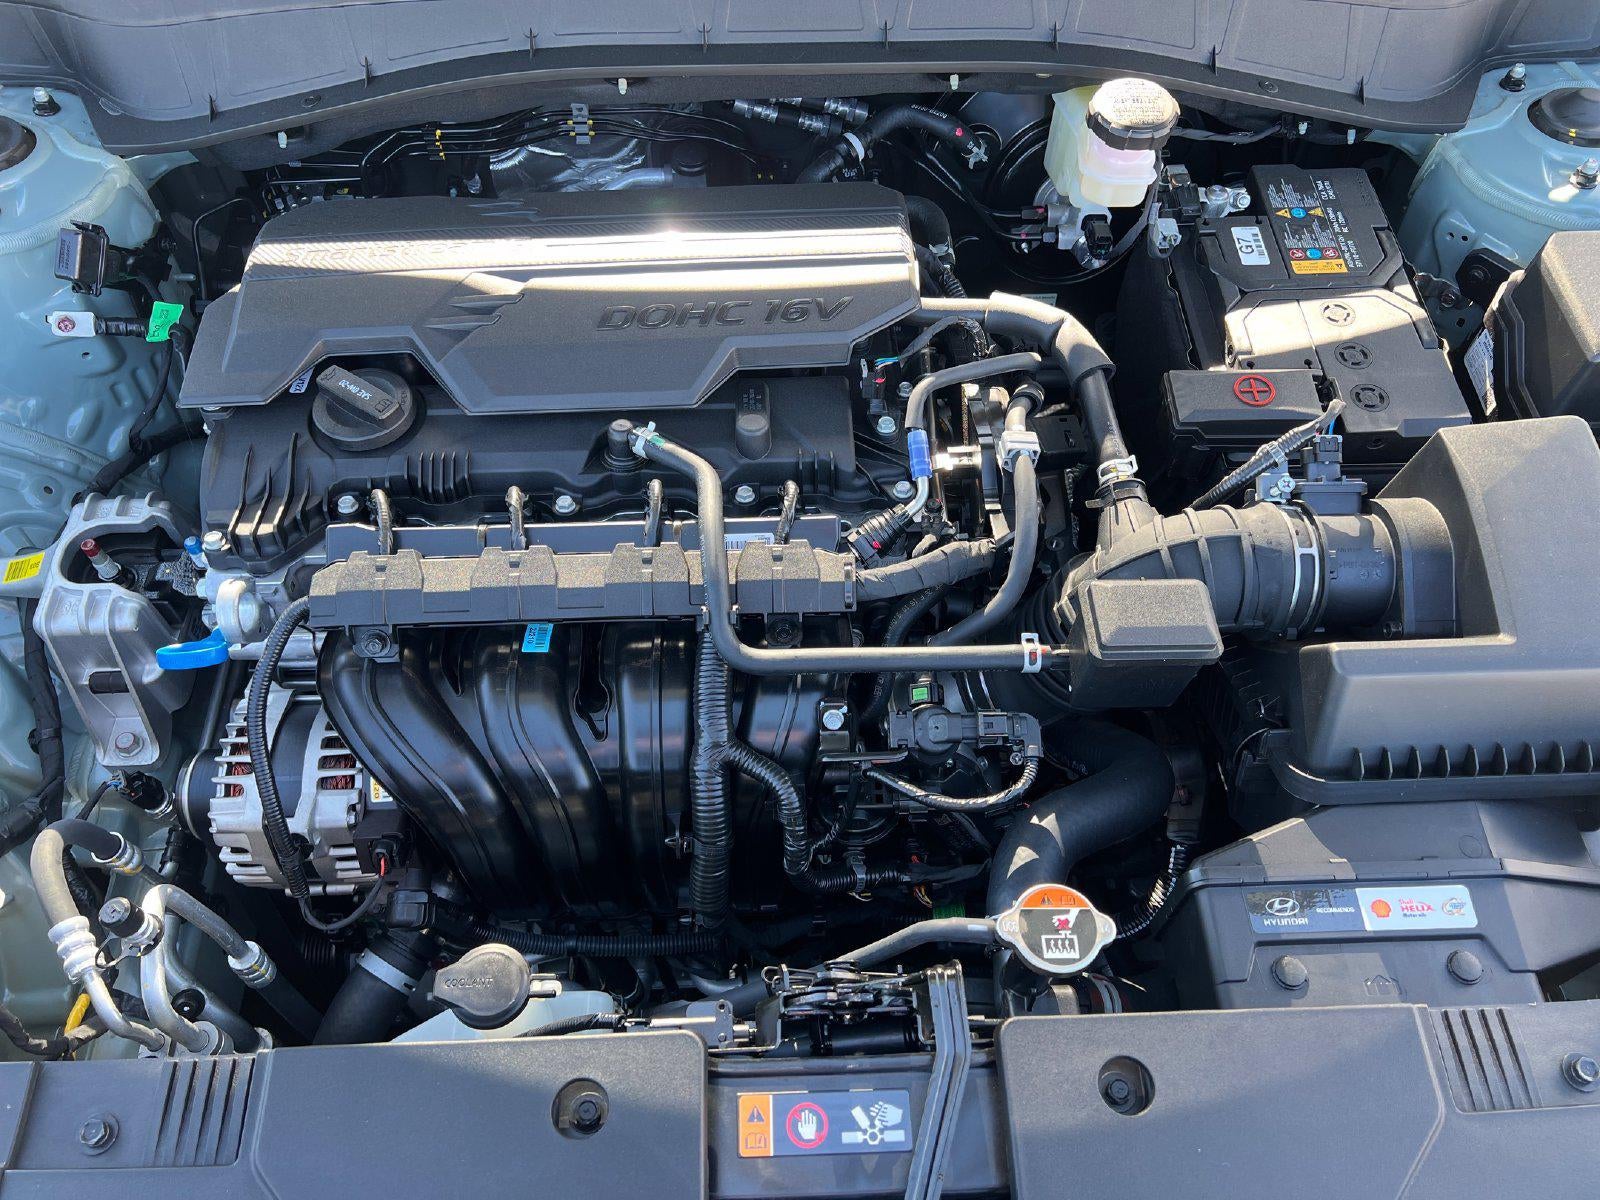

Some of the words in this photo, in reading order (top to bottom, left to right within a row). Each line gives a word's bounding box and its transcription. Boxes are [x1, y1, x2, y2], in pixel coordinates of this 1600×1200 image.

[1236, 237, 1255, 255] G7
[597, 300, 753, 332] DOHC
[763, 296, 855, 325] 16V
[1315, 905, 1356, 914] RECOMMENDS
[1400, 904, 1435, 913] HELIX
[1263, 917, 1309, 927] HYUNDAI
[444, 977, 494, 989] COOLANT
